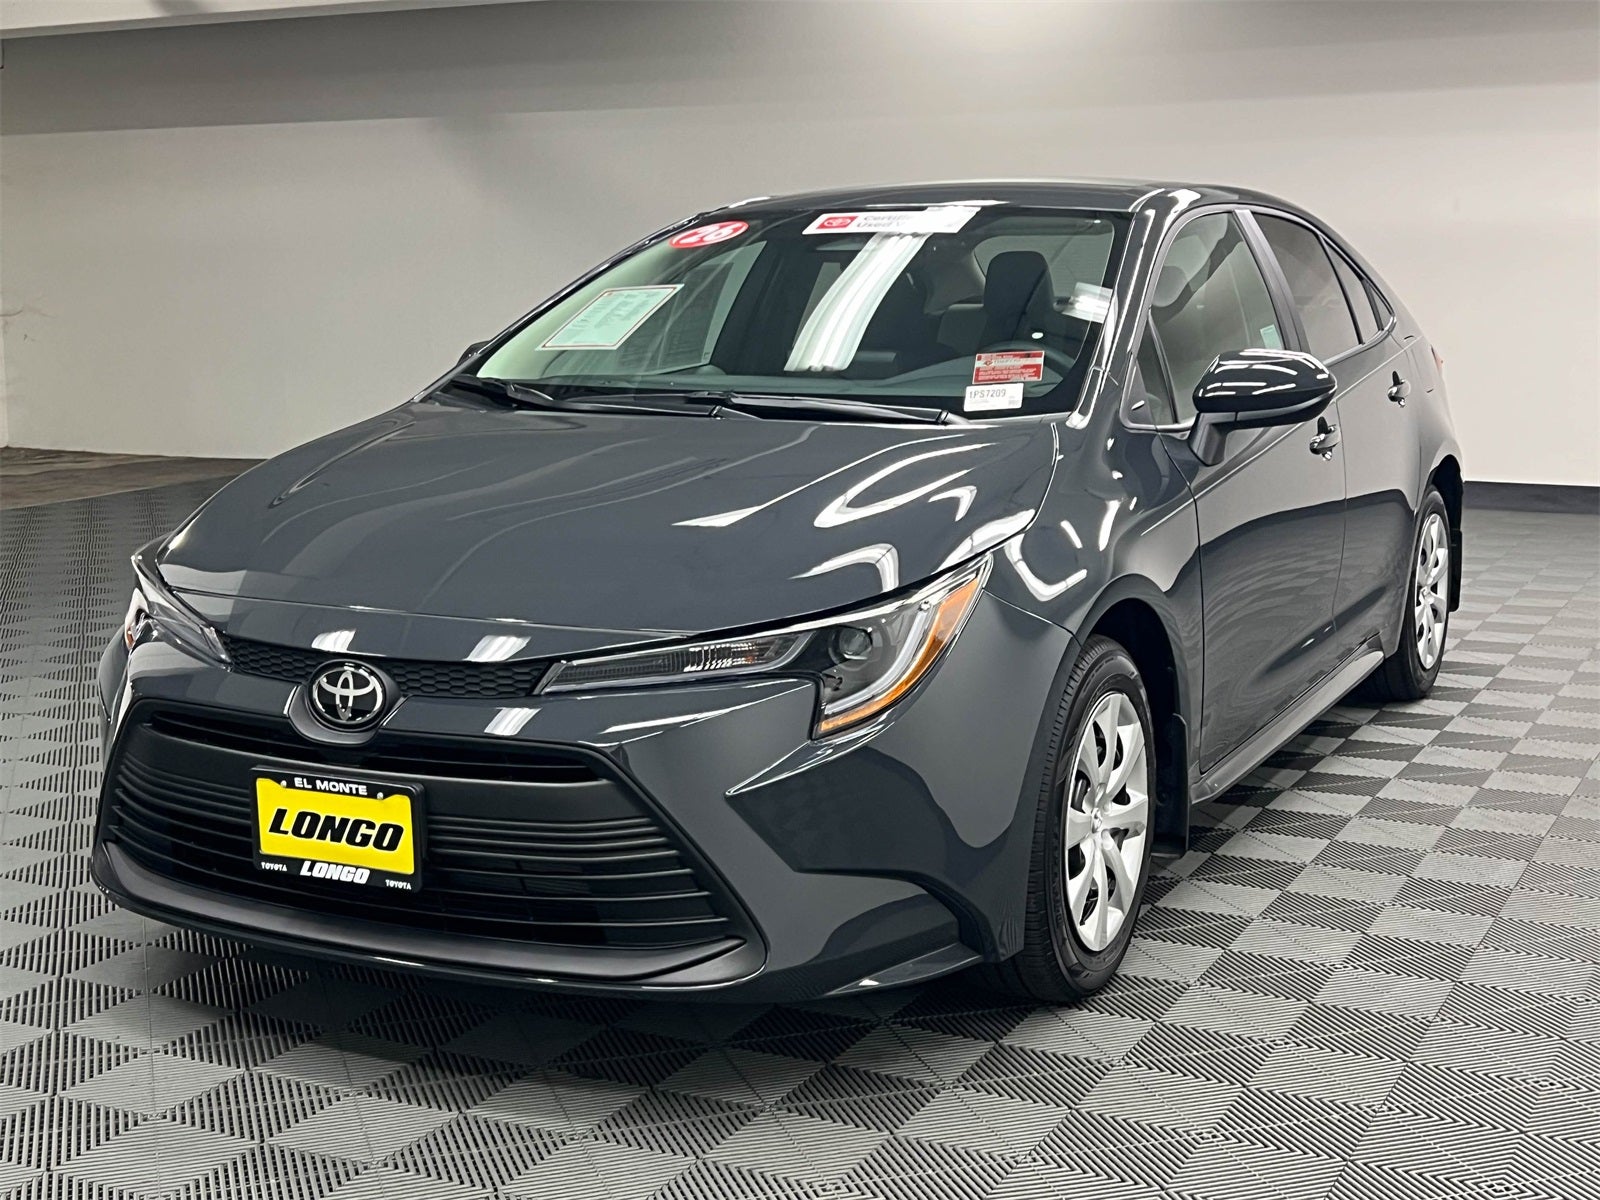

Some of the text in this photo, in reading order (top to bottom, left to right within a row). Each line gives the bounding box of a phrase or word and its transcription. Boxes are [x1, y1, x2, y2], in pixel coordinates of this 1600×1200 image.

[294, 777, 368, 796] EL MONTE
[268, 808, 404, 852] LONGO
[261, 861, 287, 872] TOYOTA
[300, 860, 371, 885] LONGO
[385, 879, 412, 890] TOYOTA
